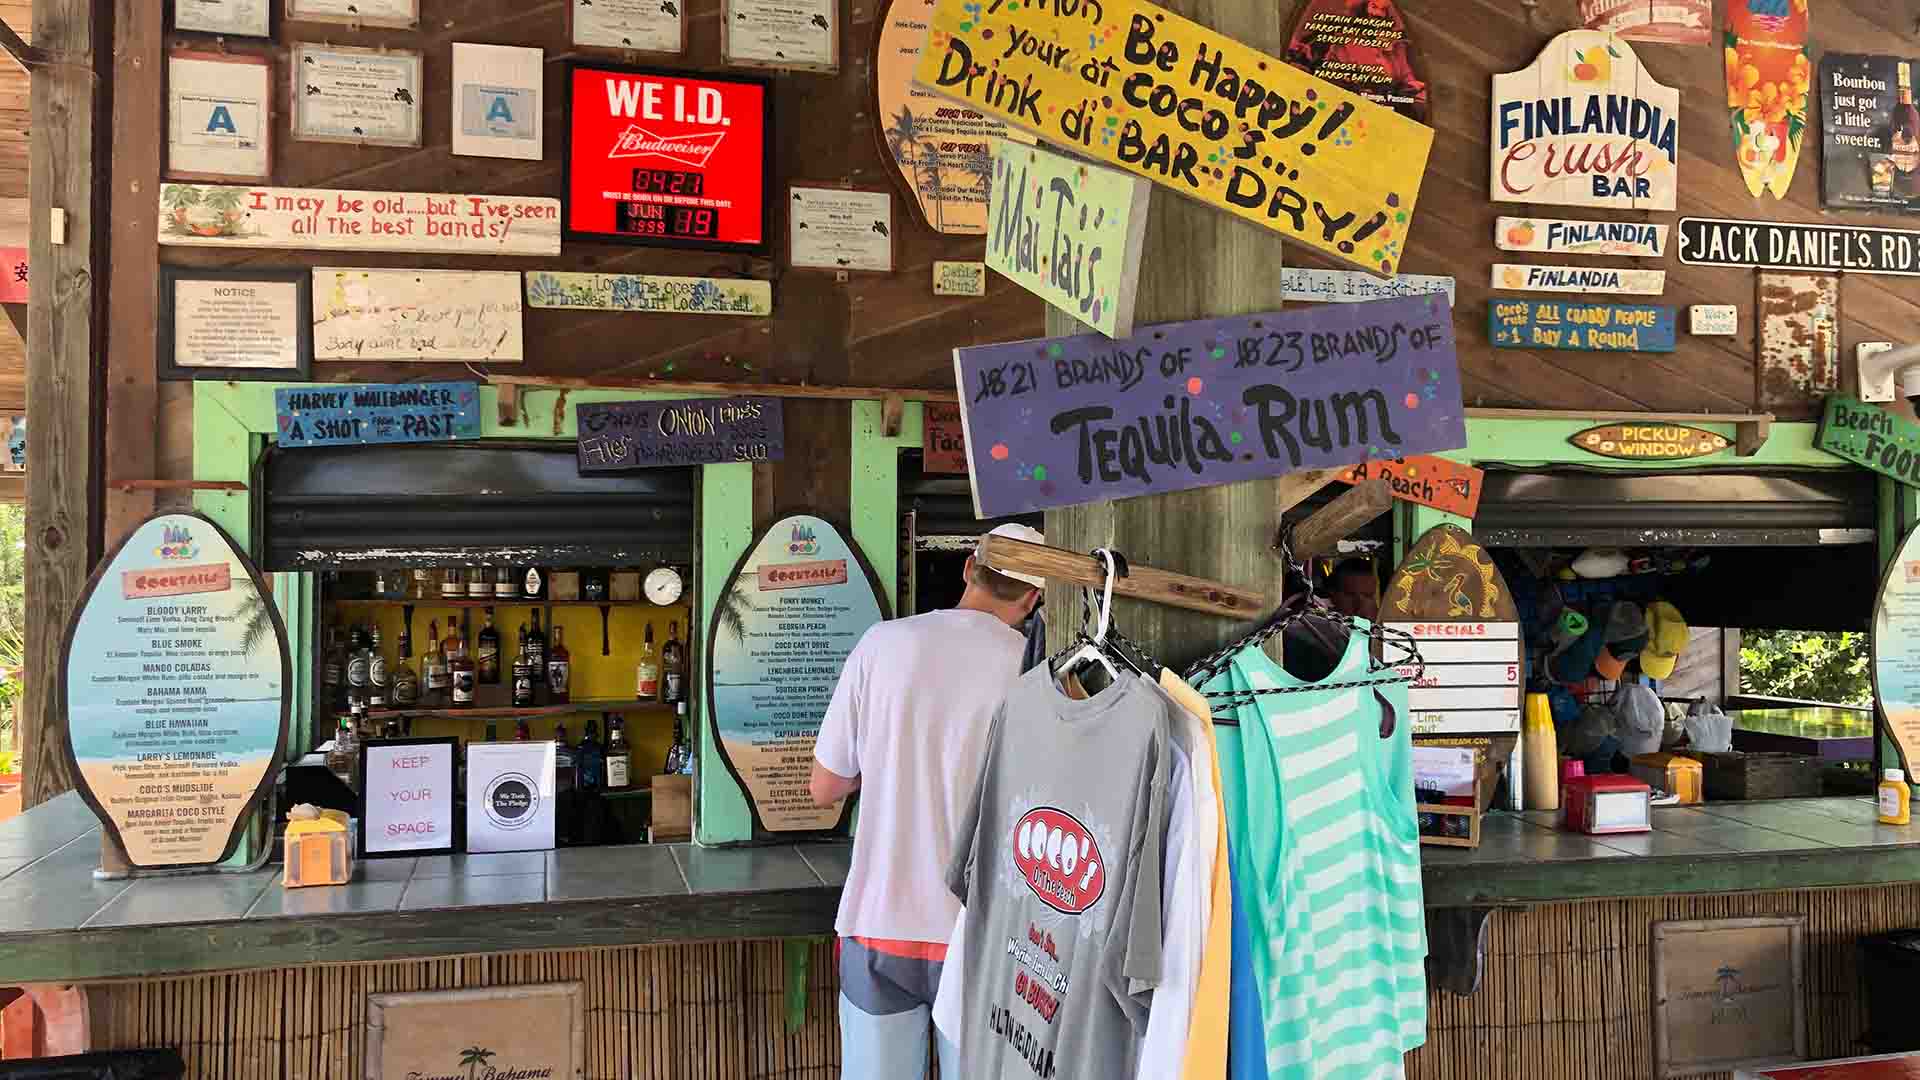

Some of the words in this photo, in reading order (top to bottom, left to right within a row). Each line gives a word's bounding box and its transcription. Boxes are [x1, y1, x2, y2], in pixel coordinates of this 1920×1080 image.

[1304, 22, 1340, 32] PARROT
[1342, 26, 1360, 36] BAY
[1313, 13, 1351, 24] CAPTAIN
[1354, 17, 1394, 28] MORGAN
[1317, 34, 1352, 44] SERVED
[1353, 38, 1389, 48] FROZEN
[1003, 23, 1070, 69] your
[1080, 55, 1121, 88] at
[1322, 60, 1357, 71] CHOOSE
[1360, 63, 1385, 74] YOUR
[1124, 13, 1179, 73] Be
[1189, 41, 1355, 157] Happy!
[1313, 70, 1350, 80] PARROT
[1351, 72, 1370, 82] BAY
[1372, 75, 1393, 84] RUM
[1833, 72, 1886, 91] Bourbon
[487, 95, 513, 122] A
[606, 79, 664, 120] WE
[674, 85, 731, 126] I.D.
[1833, 92, 1855, 110] just
[1858, 96, 1877, 112] got
[206, 106, 237, 133] A
[1834, 114, 1841, 125] a
[1845, 112, 1871, 128] little
[1500, 94, 1676, 165] FINLANDIA
[619, 132, 713, 155] Budweiser
[935, 37, 1043, 126] Drink
[1060, 98, 1098, 146] di
[1225, 164, 1387, 254] DRY!
[1835, 134, 1881, 148] sweeter.
[1501, 138, 1650, 196] Crush
[1592, 175, 1651, 199] BAR
[249, 192, 267, 210] I
[275, 196, 325, 216] may
[337, 194, 363, 213] be
[468, 196, 510, 218] I've
[514, 202, 557, 219] seen
[994, 162, 1043, 274] Mai
[291, 218, 318, 235] all
[371, 217, 414, 236] best
[426, 217, 512, 238] bands!
[1547, 223, 1658, 253] FINLANDIA
[1692, 224, 1759, 262] JACK
[1882, 235, 1912, 269] RD
[1527, 268, 1619, 288] FINLANDIA
[214, 288, 256, 297] NOTICE
[1536, 304, 1560, 321] ALL
[1310, 323, 1406, 363] BRANDS
[1409, 324, 1441, 350] OF
[1588, 328, 1639, 350] Round
[1056, 346, 1152, 393] BRANDS
[1159, 347, 1192, 377] OF
[288, 391, 348, 411] HARVEY
[290, 420, 305, 440] A
[313, 418, 362, 440] SHOT
[402, 414, 456, 438] PAST
[1242, 383, 1403, 468] Rum
[1832, 404, 1893, 435] Beach
[1622, 427, 1690, 442] PICKUP
[1618, 442, 1695, 456] WINDOW
[1352, 463, 1368, 481] A
[135, 573, 218, 590] COCKTAILS
[768, 569, 836, 583] COCKTAILS
[147, 606, 179, 615] BLOODY
[182, 606, 207, 615] LARRY
[1413, 624, 1487, 635] SPECIALS
[152, 640, 172, 648] BLUE
[175, 640, 202, 648] SMOKE
[143, 664, 172, 672] MANGO
[175, 663, 211, 672] COLADAS
[1507, 666, 1518, 681] 5
[147, 688, 180, 696] BAHAMA
[183, 687, 207, 696] MAMA
[145, 720, 167, 728] BLUE
[1417, 712, 1443, 723] Lime
[1507, 713, 1519, 729] 7
[137, 752, 171, 761] LARRY'S
[174, 751, 216, 760] LEMONADE
[392, 755, 430, 769] KEEP
[140, 785, 170, 794] COCO'S
[172, 784, 214, 792] MUDSLIDE
[390, 789, 432, 802] YOUR
[128, 809, 175, 818] MARGARITA
[176, 808, 200, 816] COCO
[202, 807, 224, 815] STYLE
[387, 821, 436, 836] SPACE
